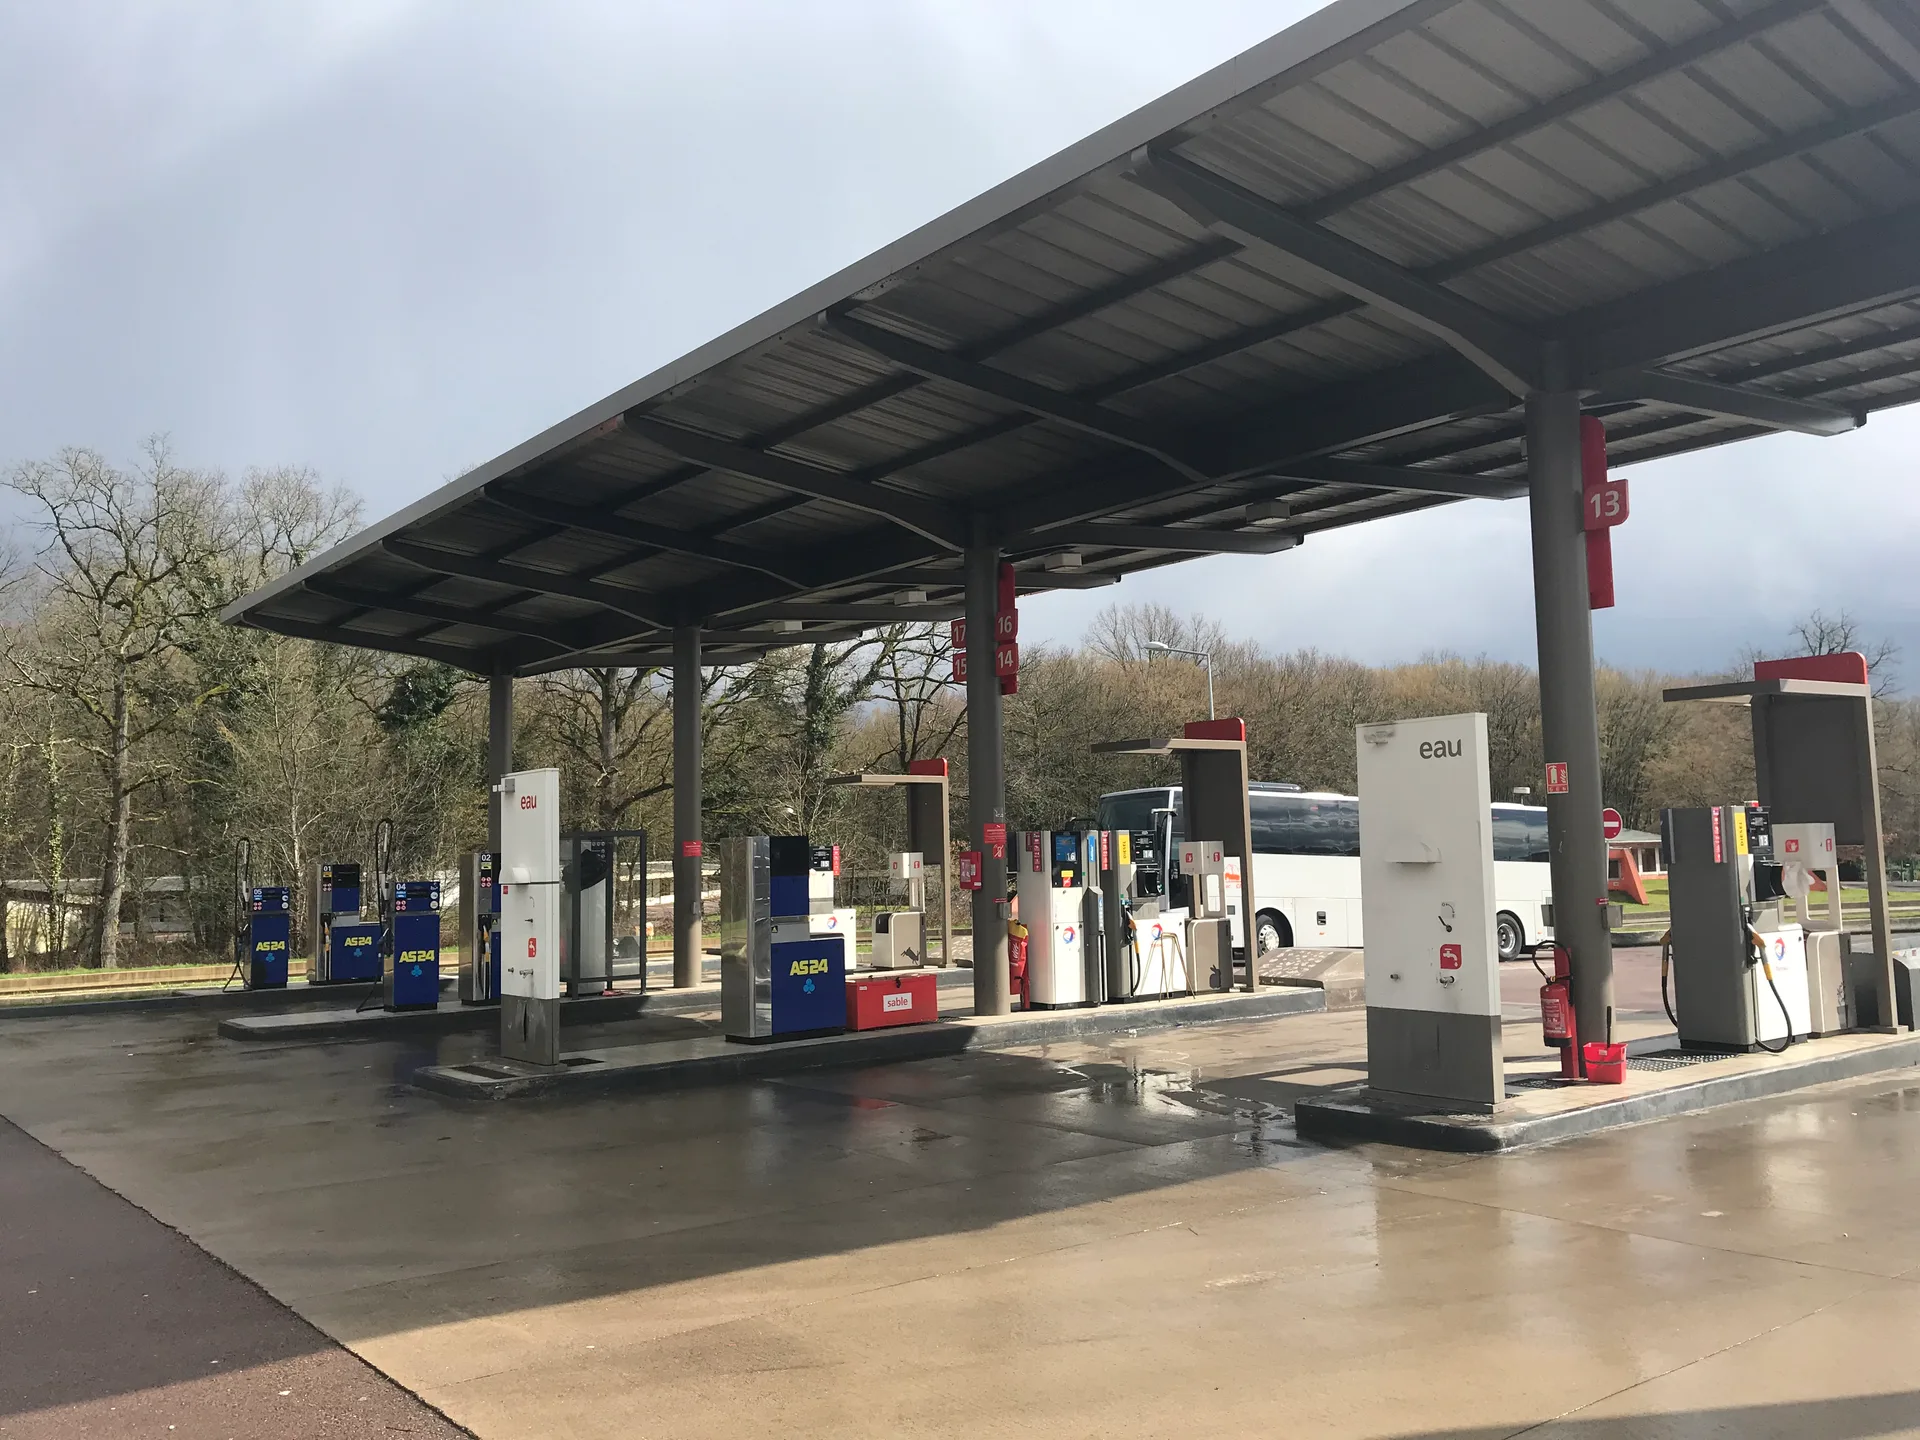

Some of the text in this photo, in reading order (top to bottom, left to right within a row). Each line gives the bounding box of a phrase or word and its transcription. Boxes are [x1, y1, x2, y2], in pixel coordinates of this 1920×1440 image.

[1590, 490, 1620, 518] 13
[953, 624, 967, 642] 17
[998, 615, 1013, 634] 16
[955, 658, 967, 676] 15
[998, 650, 1014, 669] 14
[1419, 738, 1462, 759] eau
[520, 795, 537, 810] eau
[1759, 835, 1769, 845] 13
[1066, 852, 1076, 861] 16
[887, 997, 908, 1008] sable
